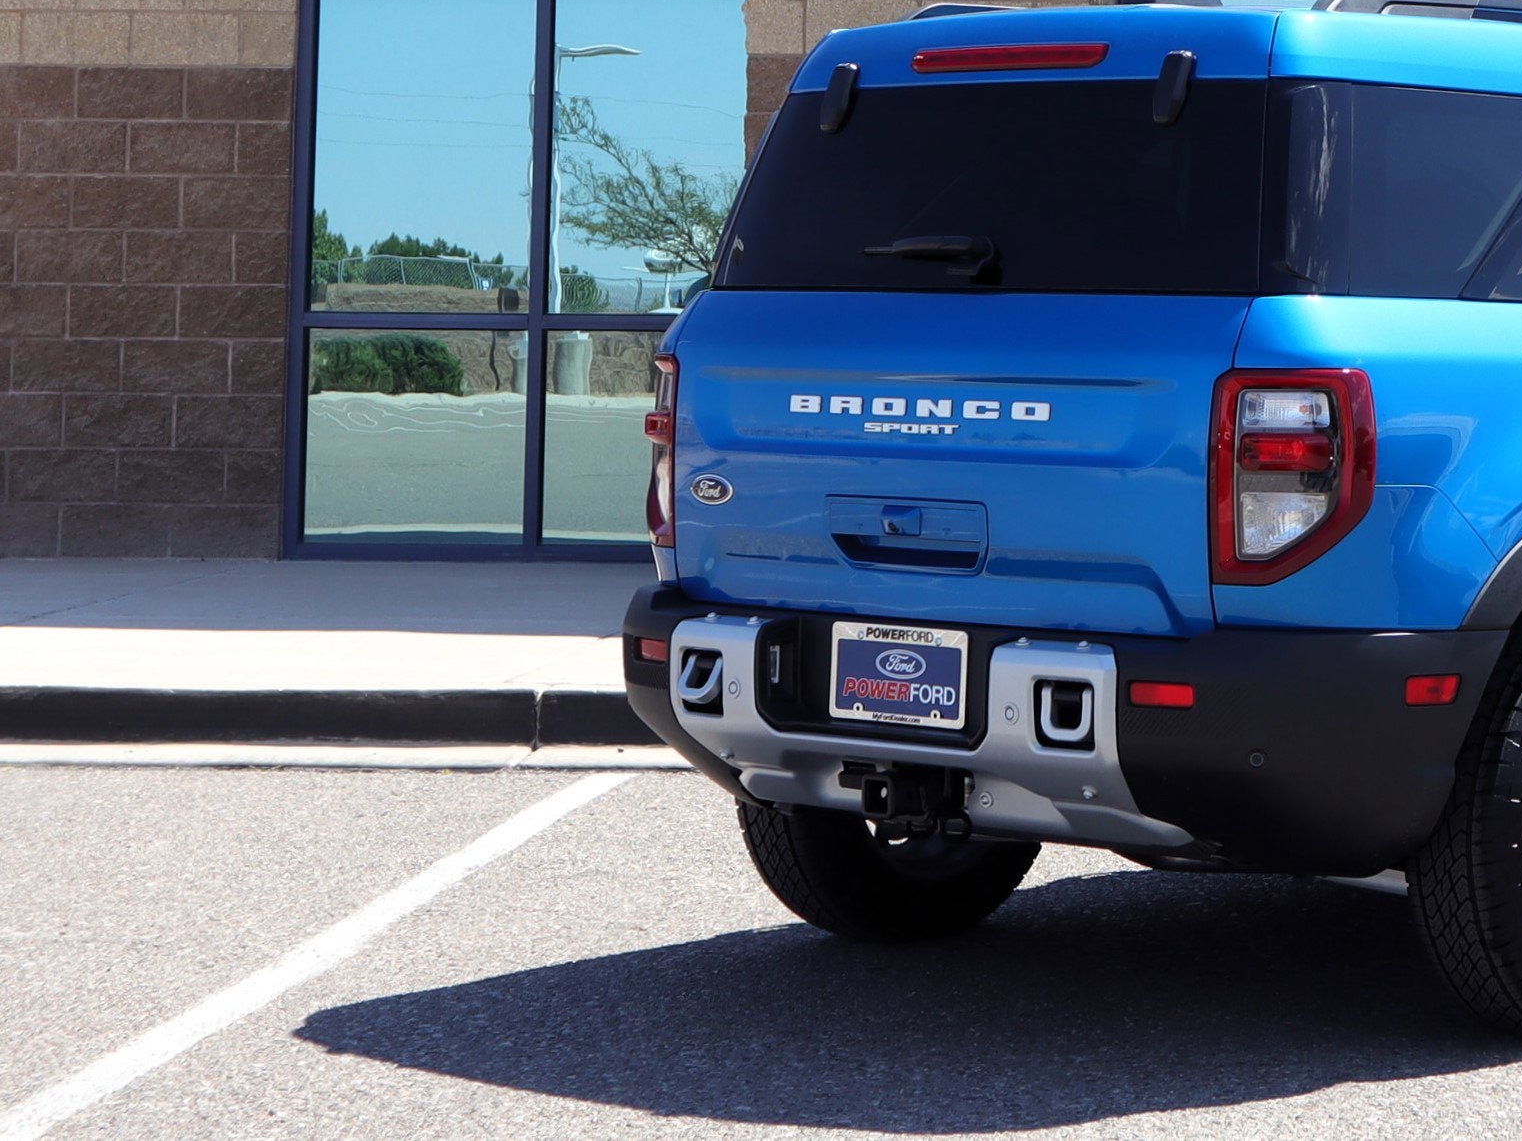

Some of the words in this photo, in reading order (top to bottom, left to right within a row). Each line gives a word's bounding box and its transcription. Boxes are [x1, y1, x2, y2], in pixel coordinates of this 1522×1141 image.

[789, 394, 1051, 421] BRONCO
[864, 422, 959, 435] SPORT
[697, 480, 721, 498] Ford
[865, 627, 934, 643] POWERFORD
[885, 654, 916, 673] Ford
[842, 676, 956, 706] POWERFORD
